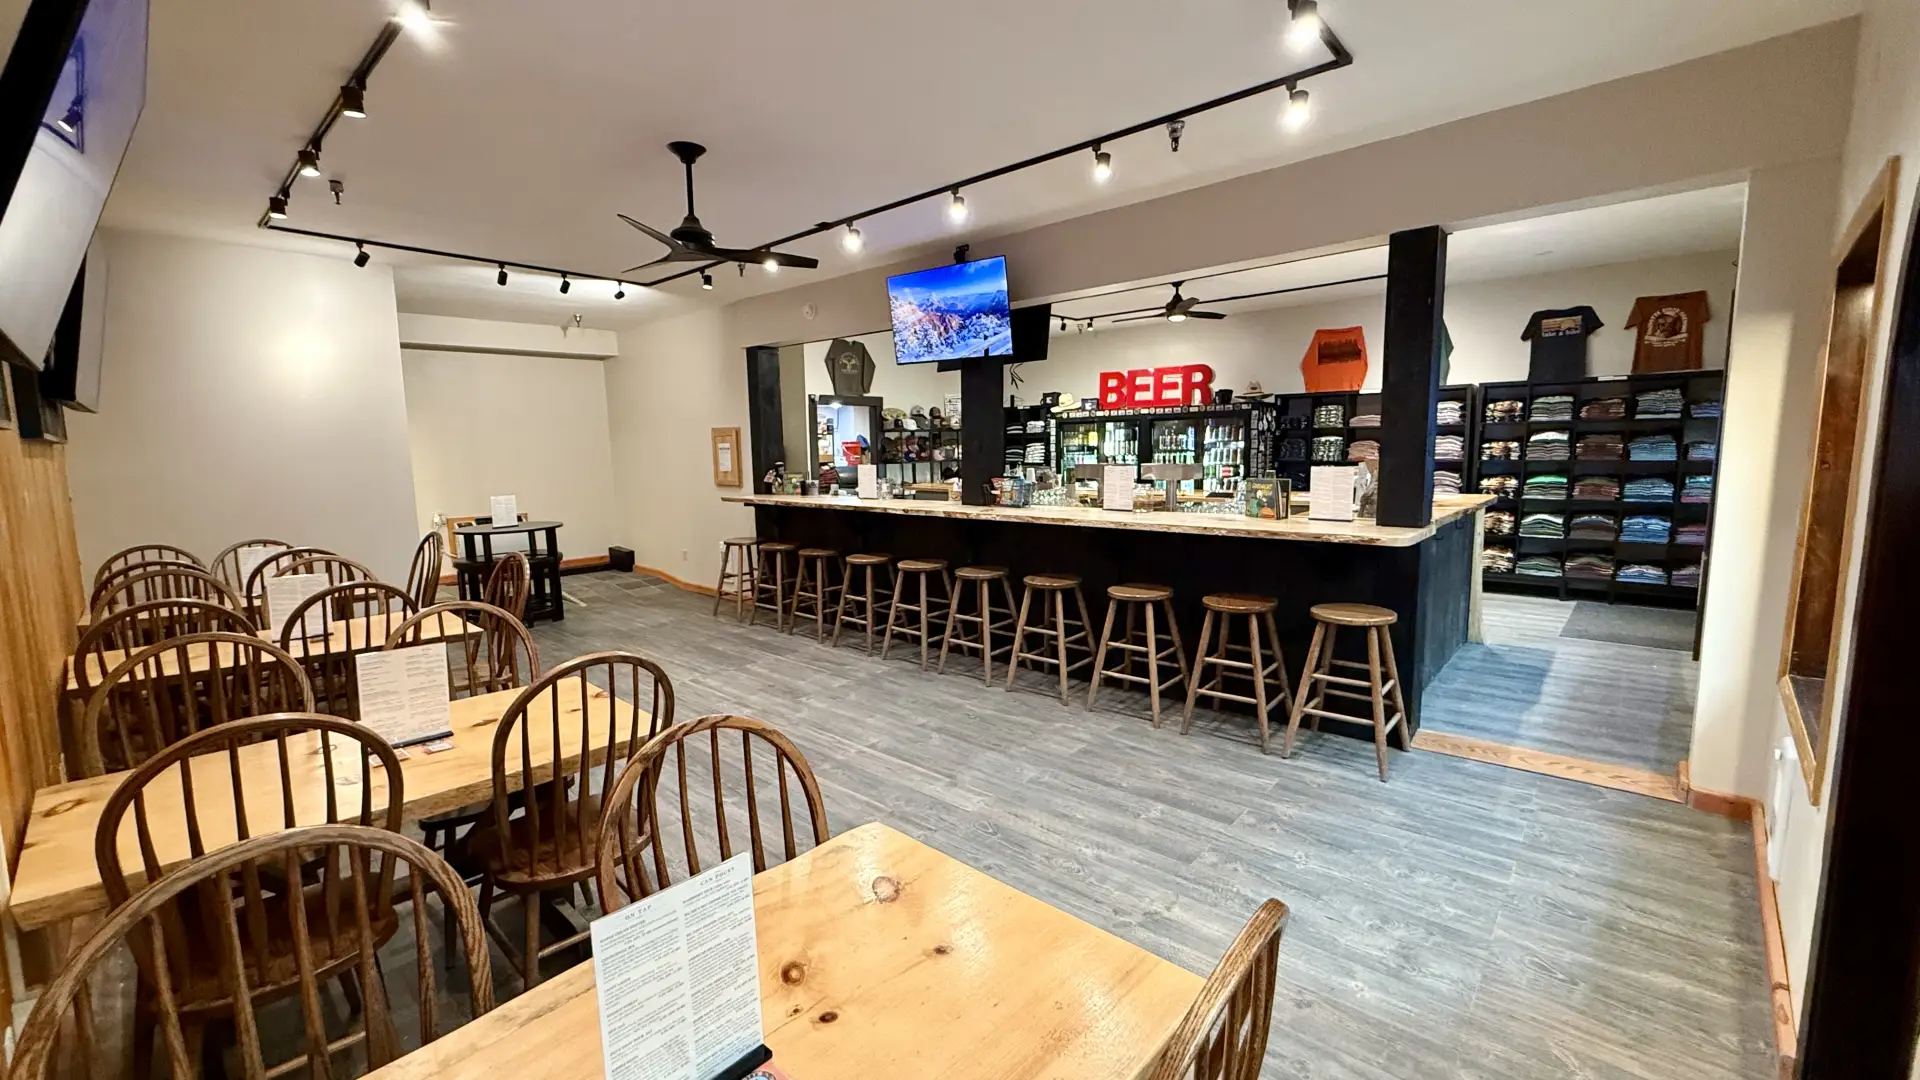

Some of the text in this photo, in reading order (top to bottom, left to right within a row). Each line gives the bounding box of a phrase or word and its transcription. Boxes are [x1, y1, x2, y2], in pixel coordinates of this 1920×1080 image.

[1099, 363, 1215, 410] BEER
[700, 877, 713, 886] CAN
[625, 905, 652, 921] ON TAP
